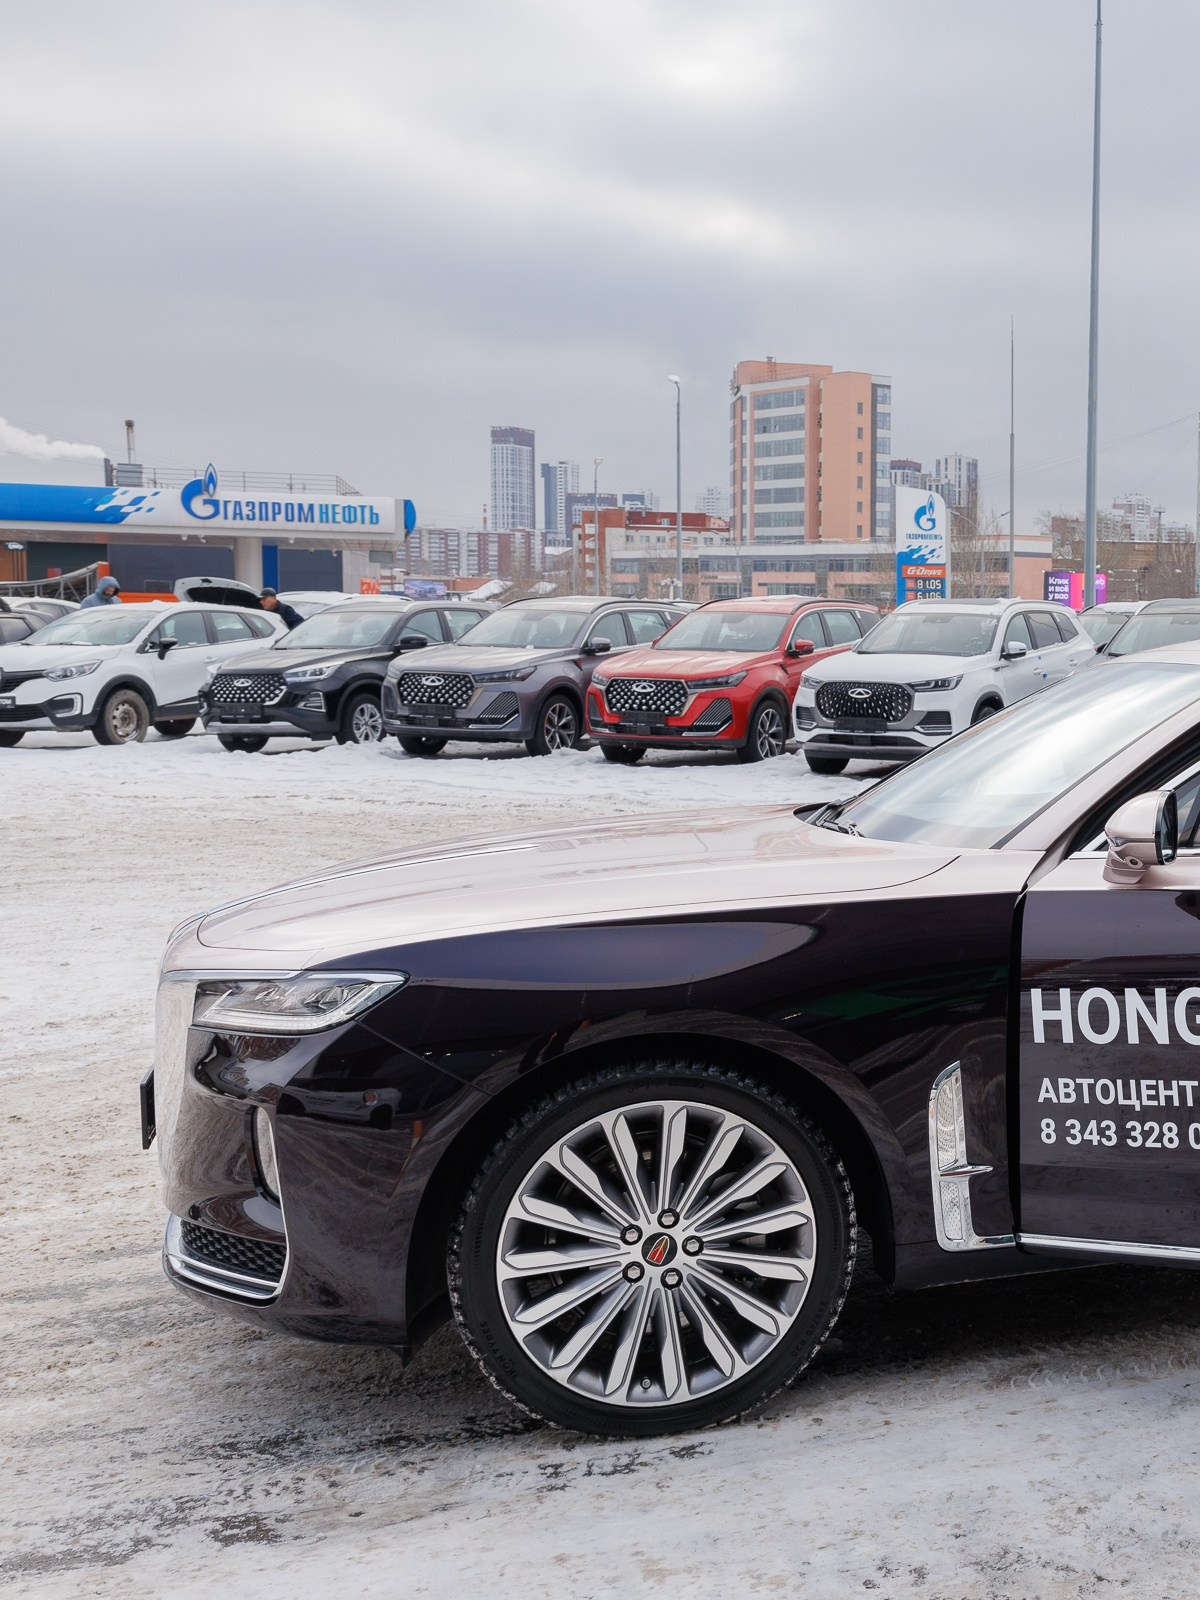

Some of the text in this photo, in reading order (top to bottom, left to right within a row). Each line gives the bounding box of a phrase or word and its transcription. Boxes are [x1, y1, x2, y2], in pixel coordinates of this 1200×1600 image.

[1049, 577, 1069, 585] Клик
[1040, 1117, 1057, 1145] 8
[1065, 1118, 1118, 1147] 343
[1125, 1120, 1180, 1149] 328
